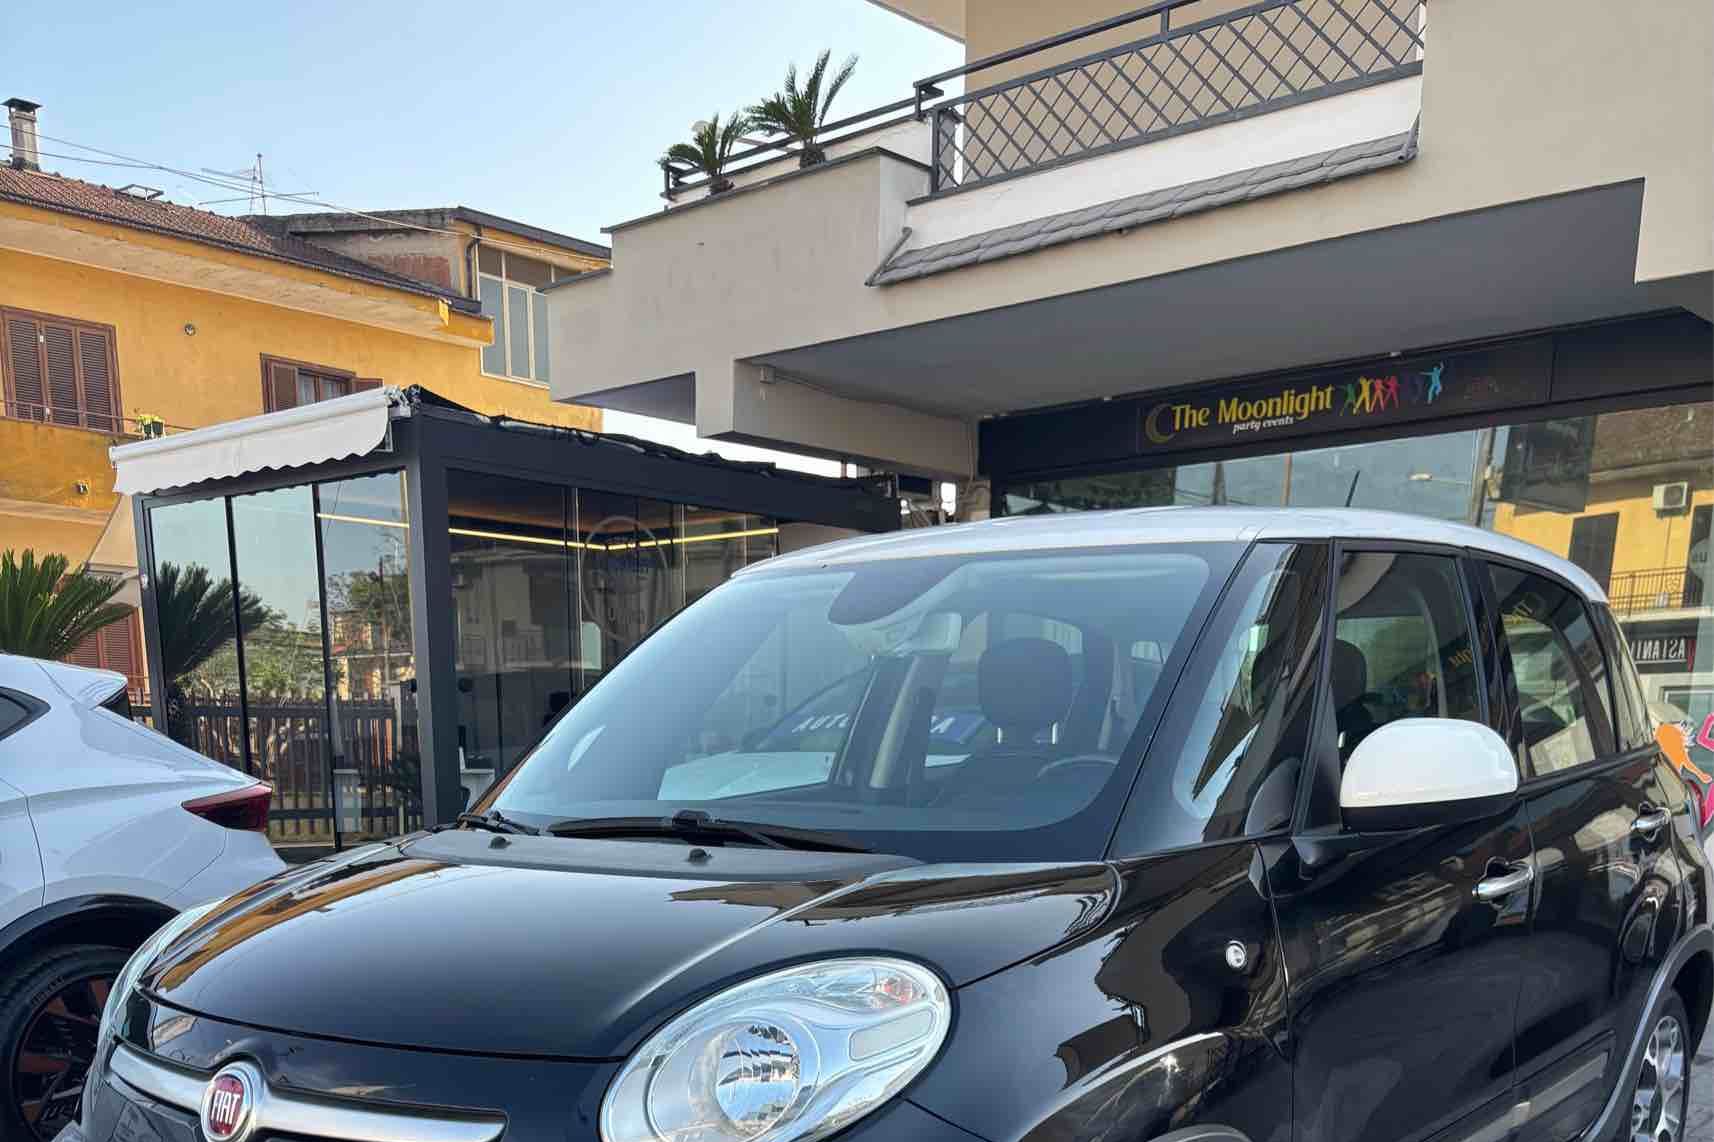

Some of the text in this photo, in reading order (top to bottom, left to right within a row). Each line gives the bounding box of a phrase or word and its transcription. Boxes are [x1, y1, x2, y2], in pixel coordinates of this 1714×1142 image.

[1171, 384, 1335, 431] The Moonlight
[1232, 415, 1294, 435] party events
[210, 1089, 241, 1125] FIAT
